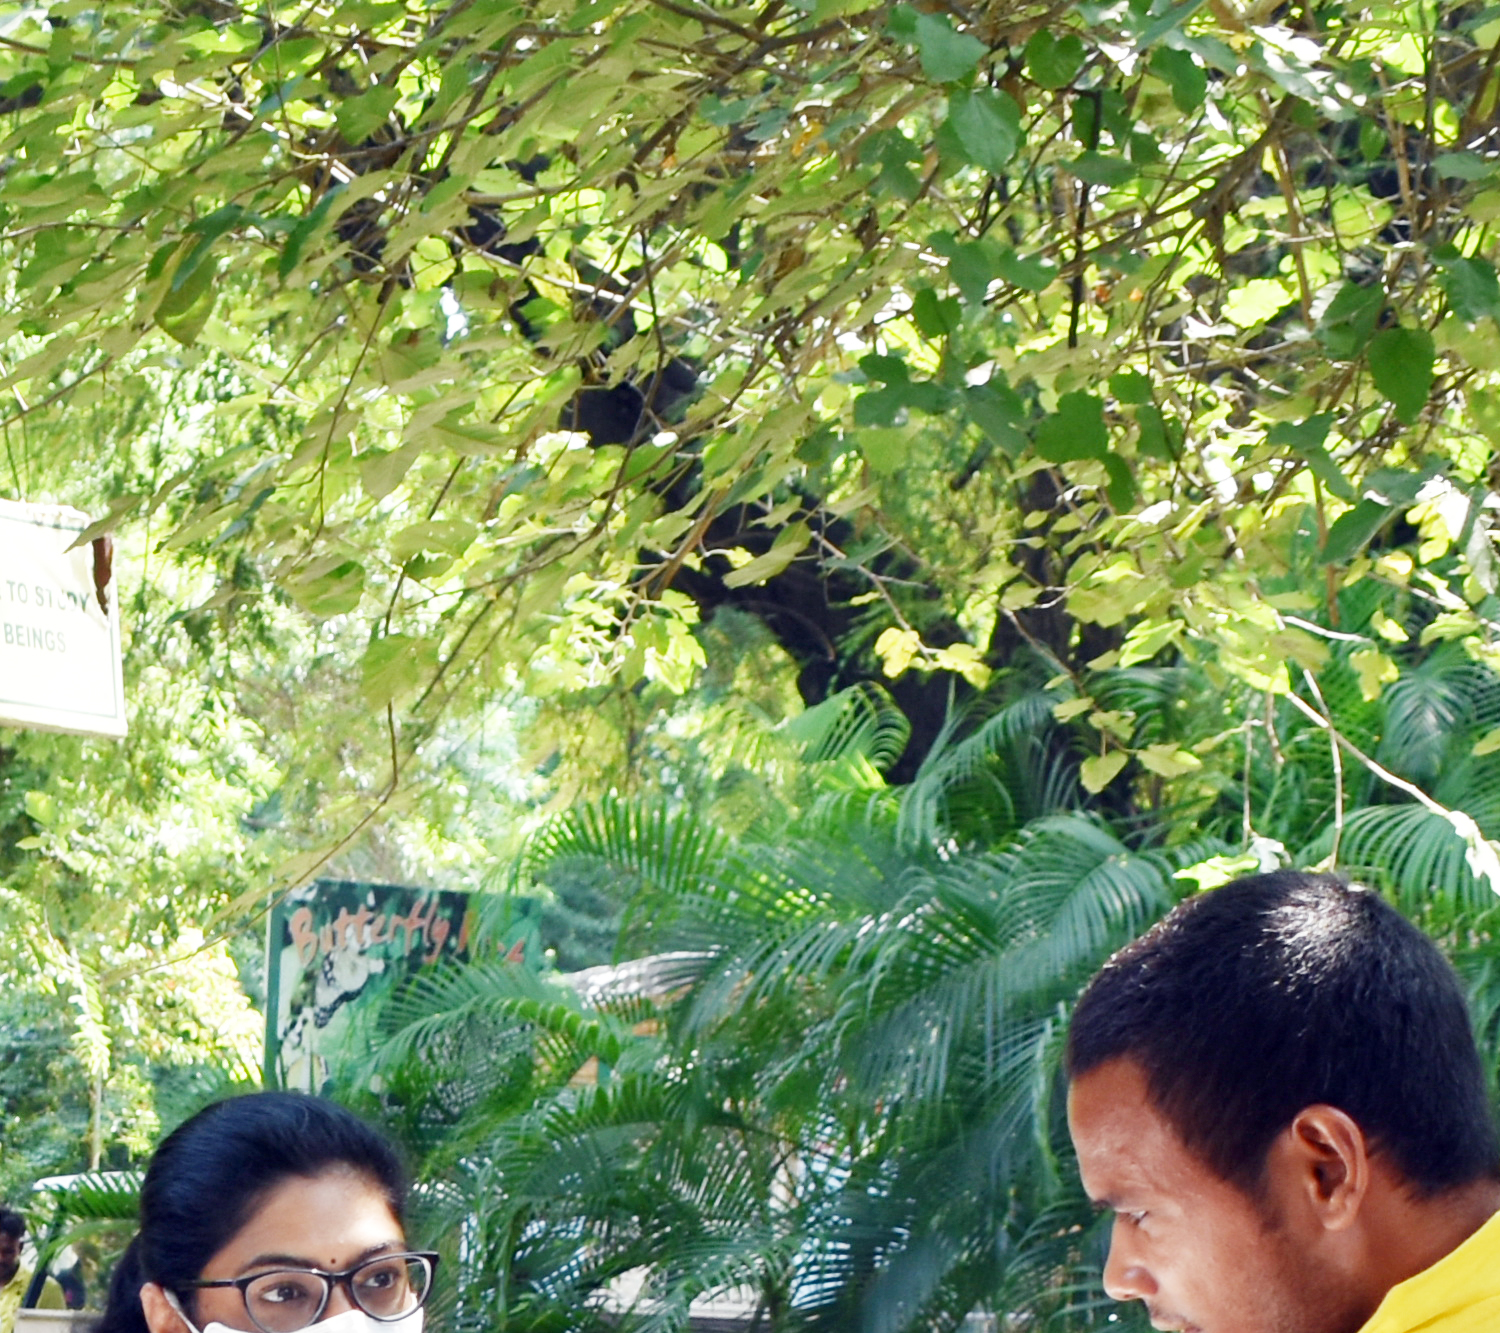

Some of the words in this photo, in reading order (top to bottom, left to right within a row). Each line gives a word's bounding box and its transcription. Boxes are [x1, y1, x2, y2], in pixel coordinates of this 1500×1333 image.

[6, 579, 28, 604] TO
[34, 584, 90, 614] STUDY
[3, 621, 66, 653] BEINGS
[289, 890, 451, 966] Butterfly
